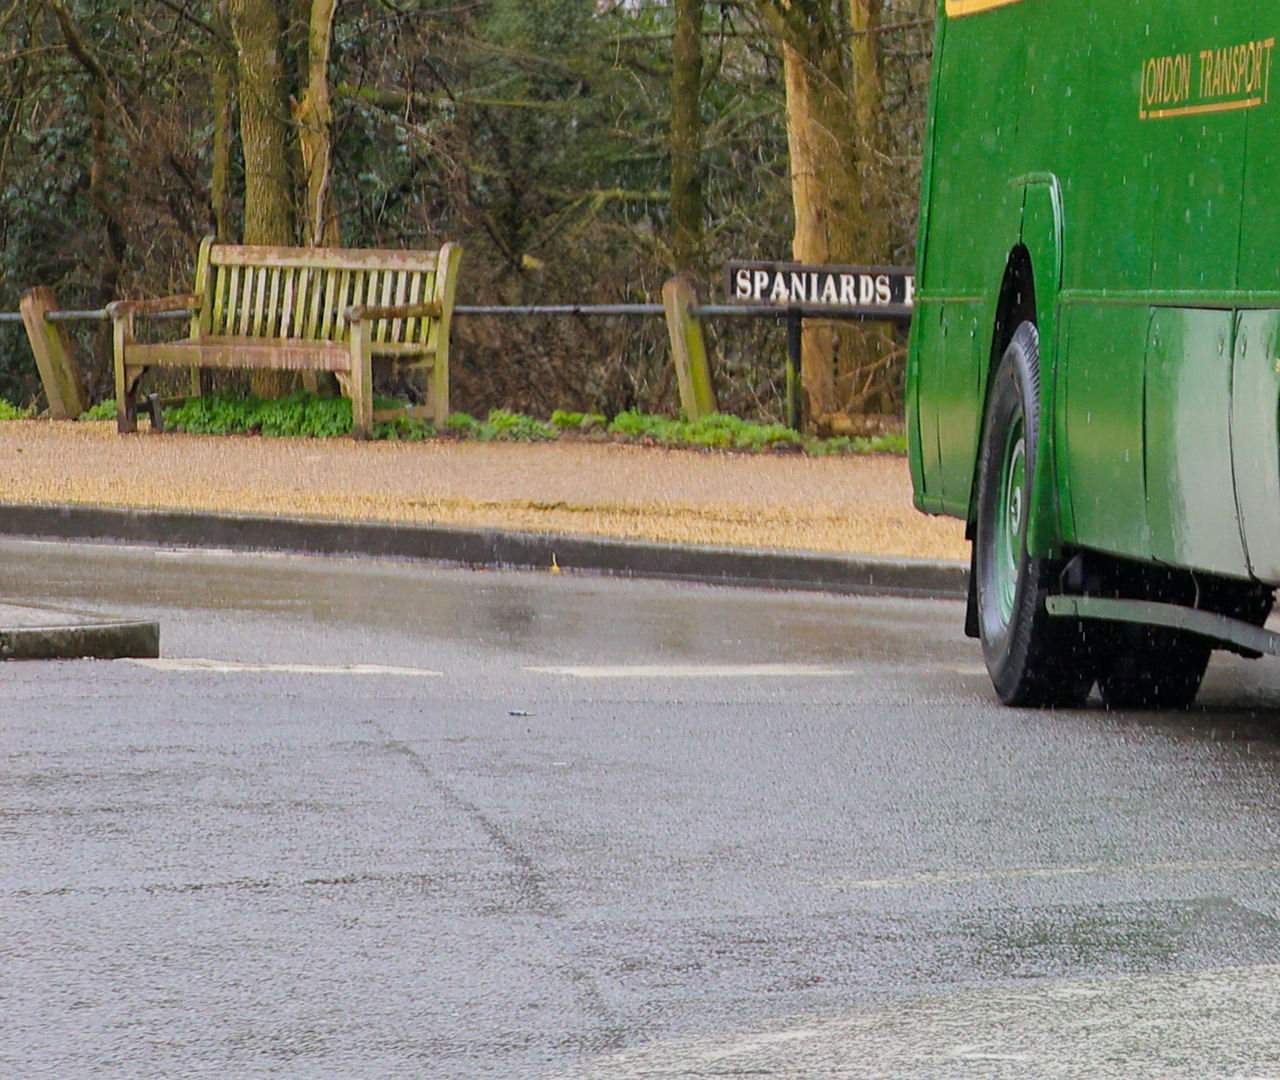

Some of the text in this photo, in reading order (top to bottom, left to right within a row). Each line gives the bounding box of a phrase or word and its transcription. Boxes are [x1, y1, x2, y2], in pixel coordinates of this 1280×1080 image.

[1139, 37, 1276, 120] LONDON TRANSPORT
[736, 269, 892, 307] SPANIARDS
